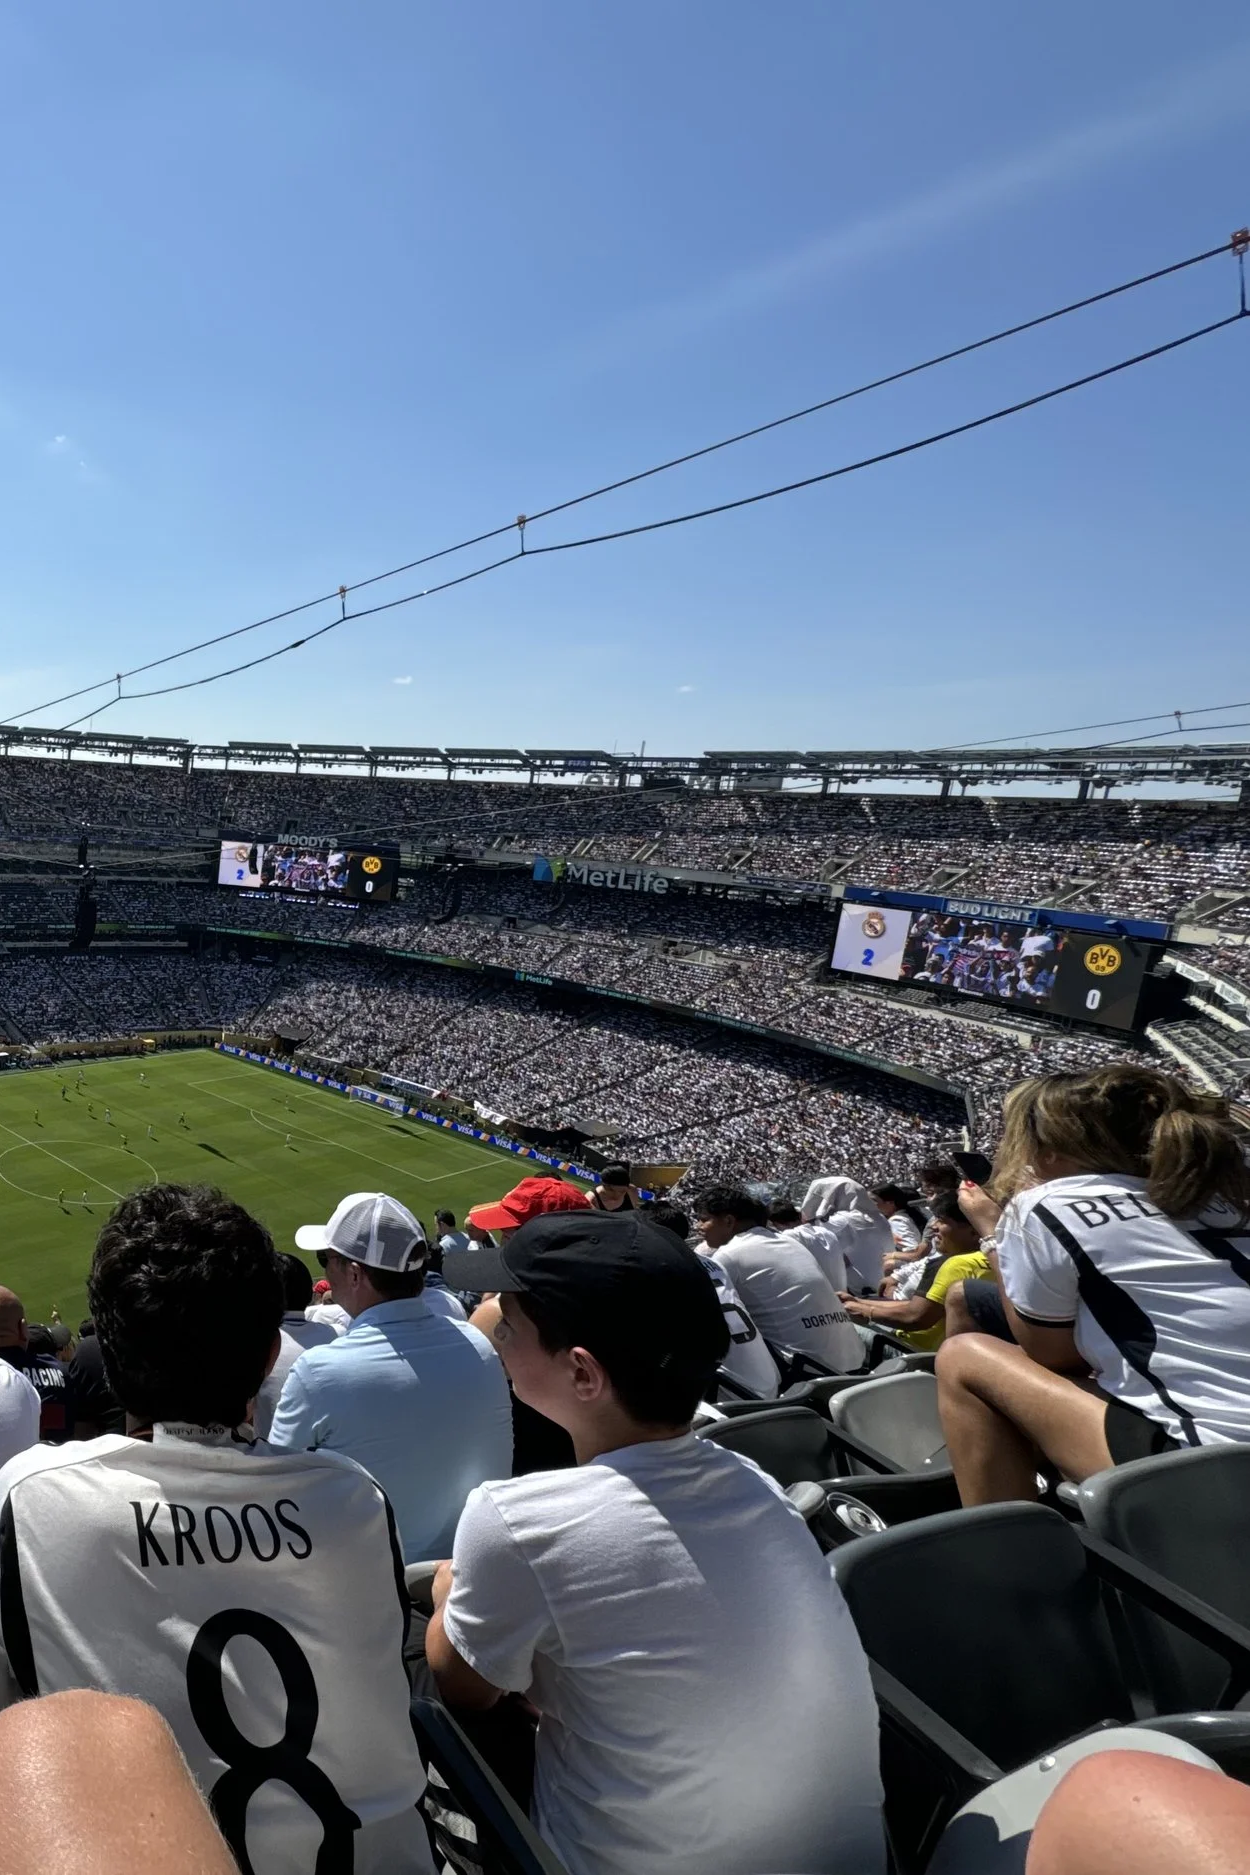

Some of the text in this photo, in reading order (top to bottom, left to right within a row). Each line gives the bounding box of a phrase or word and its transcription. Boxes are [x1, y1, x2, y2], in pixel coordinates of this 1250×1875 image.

[277, 834, 338, 848] MOODY'S
[236, 868, 245, 880] 2
[567, 863, 669, 894] MetLife
[365, 880, 374, 893] 0
[946, 900, 1034, 922] BUD LIGHT
[861, 948, 875, 966] 2
[1089, 948, 1116, 967] BVB
[525, 974, 554, 986] MetLife
[1086, 988, 1101, 1010] 0
[357, 1089, 371, 1099] VSA
[420, 1111, 438, 1124] VISA
[456, 1125, 474, 1137] VISA
[494, 1138, 512, 1151] VISA
[534, 1150, 552, 1165] VISA
[575, 1166, 596, 1182] VISA
[22, 1366, 66, 1388] RACING
[128, 1498, 313, 1568] KROOS
[186, 1608, 362, 1875] 8
